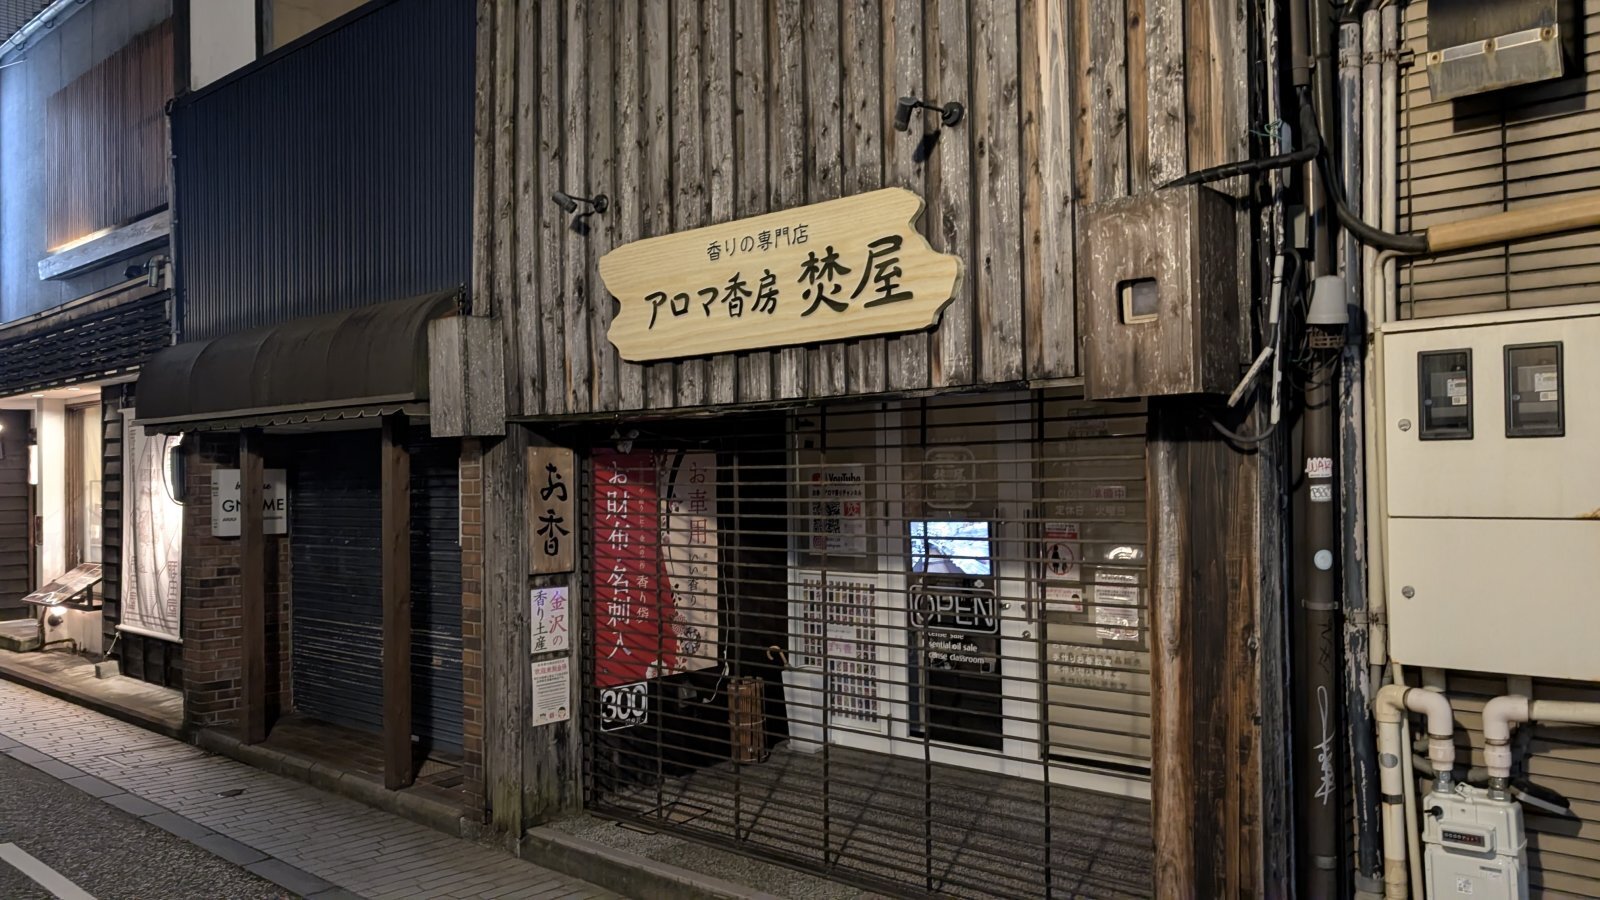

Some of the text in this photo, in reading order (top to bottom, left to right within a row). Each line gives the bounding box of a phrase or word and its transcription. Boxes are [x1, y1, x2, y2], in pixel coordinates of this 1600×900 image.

[706, 223, 810, 262] 香りの専門店
[644, 234, 914, 330] アロマ香房 焚屋
[222, 498, 284, 513] GME
[536, 462, 571, 557] お香
[687, 462, 708, 545] お車用
[533, 591, 549, 652] 香り土産
[549, 591, 567, 647] 金沢の
[914, 593, 994, 627] OPEN
[950, 653, 985, 664] classroom
[602, 685, 646, 723] 300
